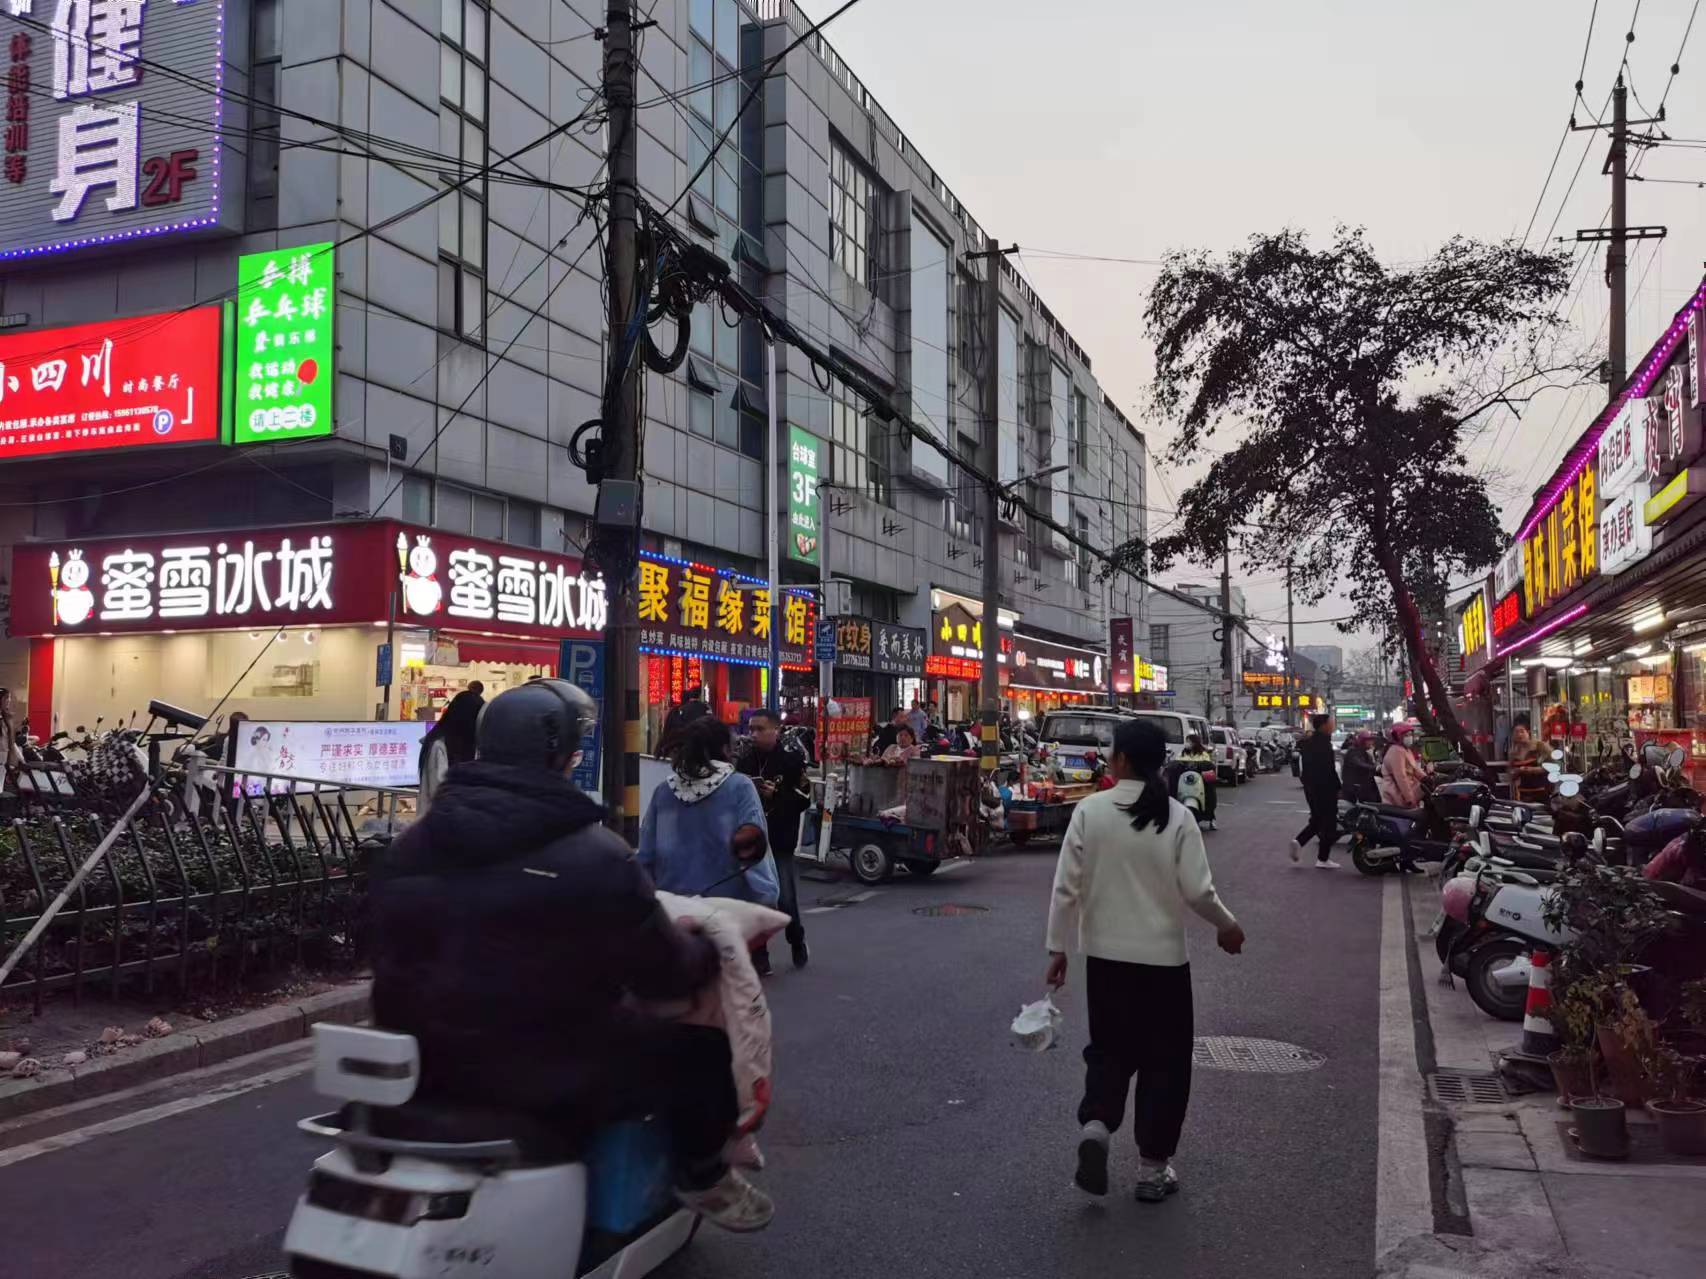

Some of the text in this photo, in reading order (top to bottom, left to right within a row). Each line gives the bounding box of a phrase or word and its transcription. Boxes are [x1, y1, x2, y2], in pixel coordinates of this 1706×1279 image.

[141, 149, 199, 207] 2F
[244, 287, 327, 326] 乒乓球
[792, 471, 816, 507] 3F
[100, 535, 334, 621] 蜜雪冰城
[446, 547, 608, 632] 蜜雪冰城
[638, 560, 807, 647] 聚福缘菜馆
[569, 644, 597, 684] P
